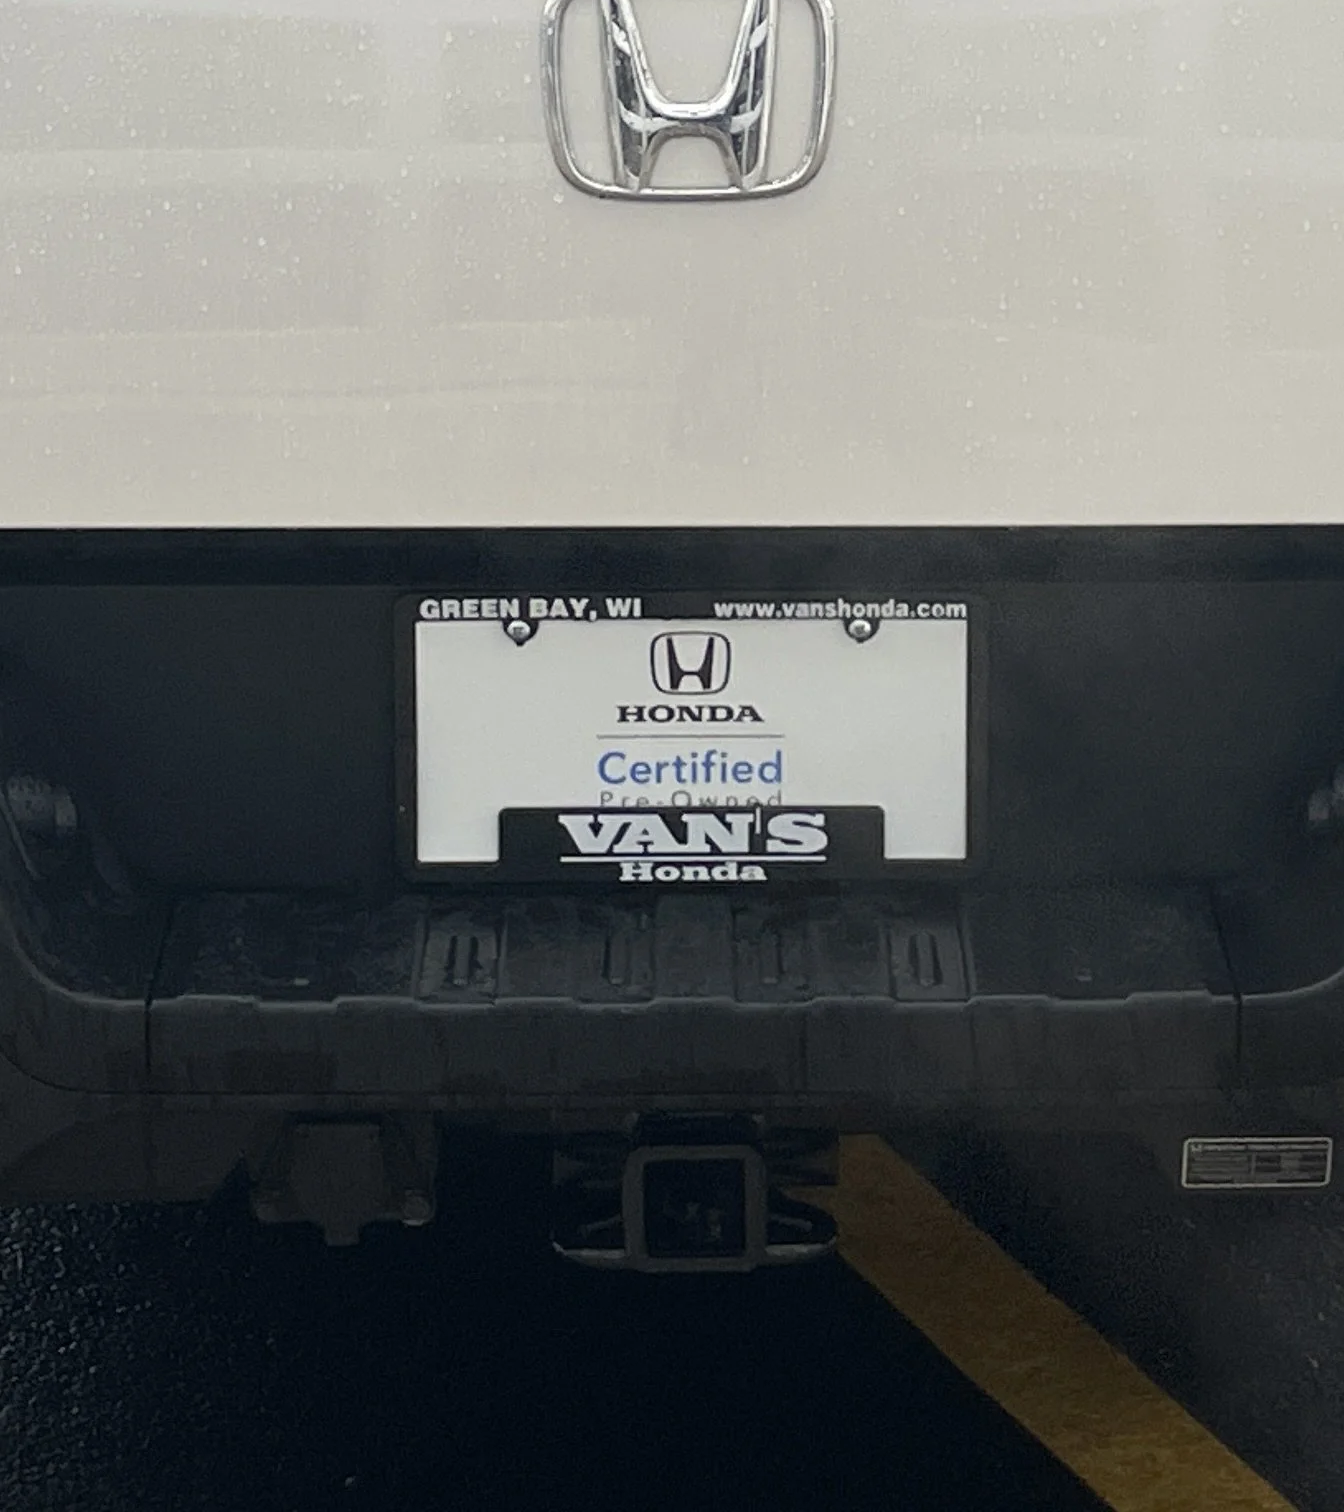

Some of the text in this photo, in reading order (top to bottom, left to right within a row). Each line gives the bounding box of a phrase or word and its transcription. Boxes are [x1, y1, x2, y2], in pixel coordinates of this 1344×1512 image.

[419, 597, 642, 622] GREEN BAY, WI
[714, 599, 967, 619] www.vanshonda.com
[616, 704, 765, 723] HONDA
[597, 749, 783, 785] Certified
[558, 804, 828, 854] VAN'S
[619, 861, 768, 882] Honda
